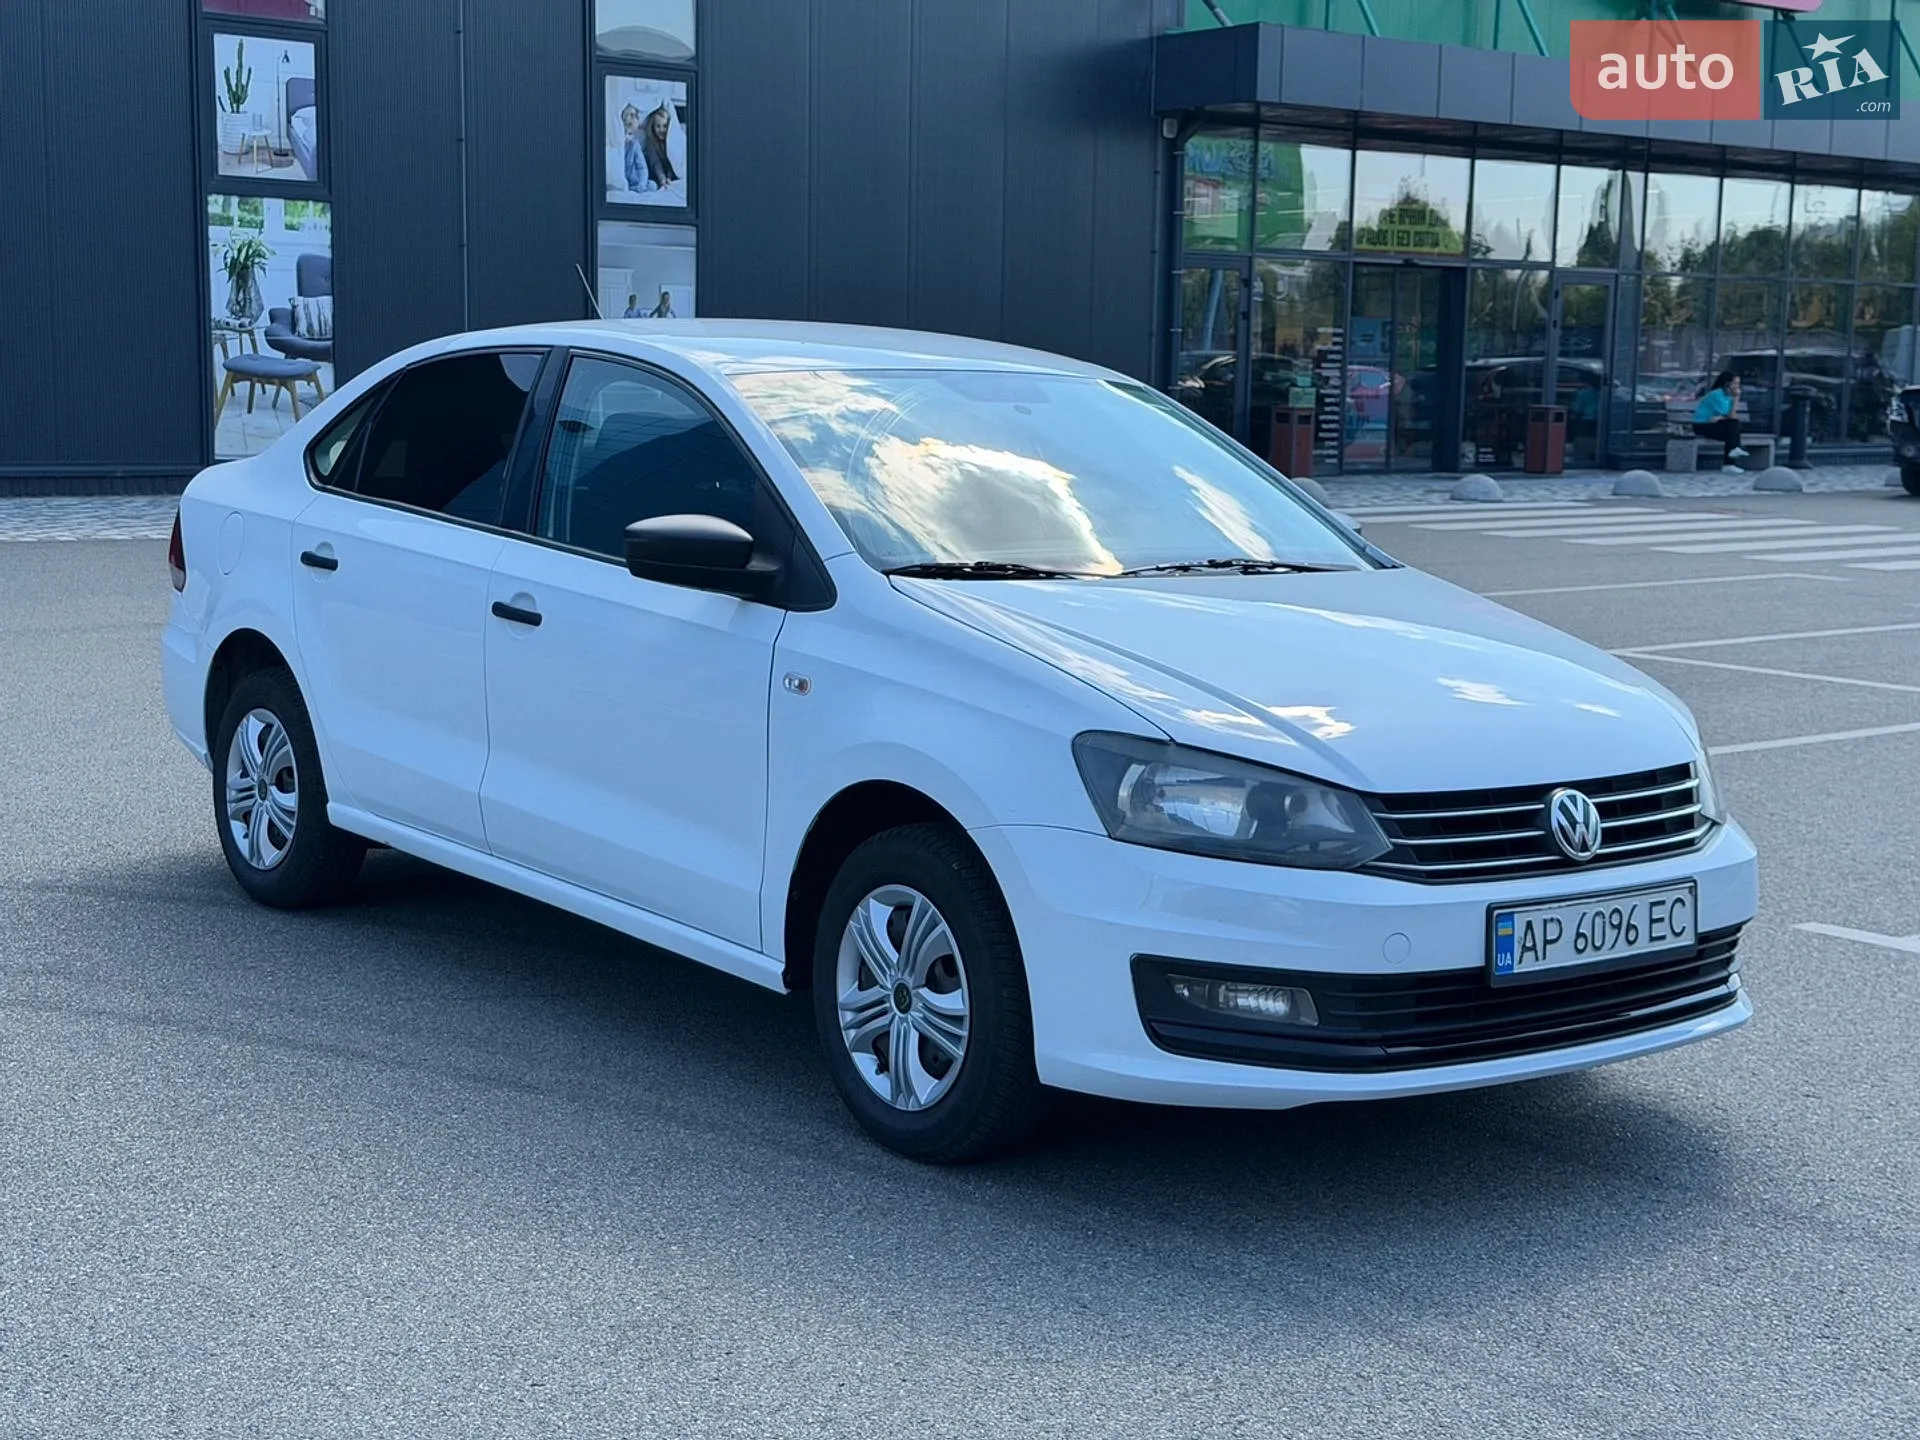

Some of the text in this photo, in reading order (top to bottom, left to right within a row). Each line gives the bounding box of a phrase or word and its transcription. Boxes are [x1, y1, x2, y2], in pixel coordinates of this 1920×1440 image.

[1518, 896, 1687, 965] AP 6096 EC
[1497, 952, 1512, 967] UA
